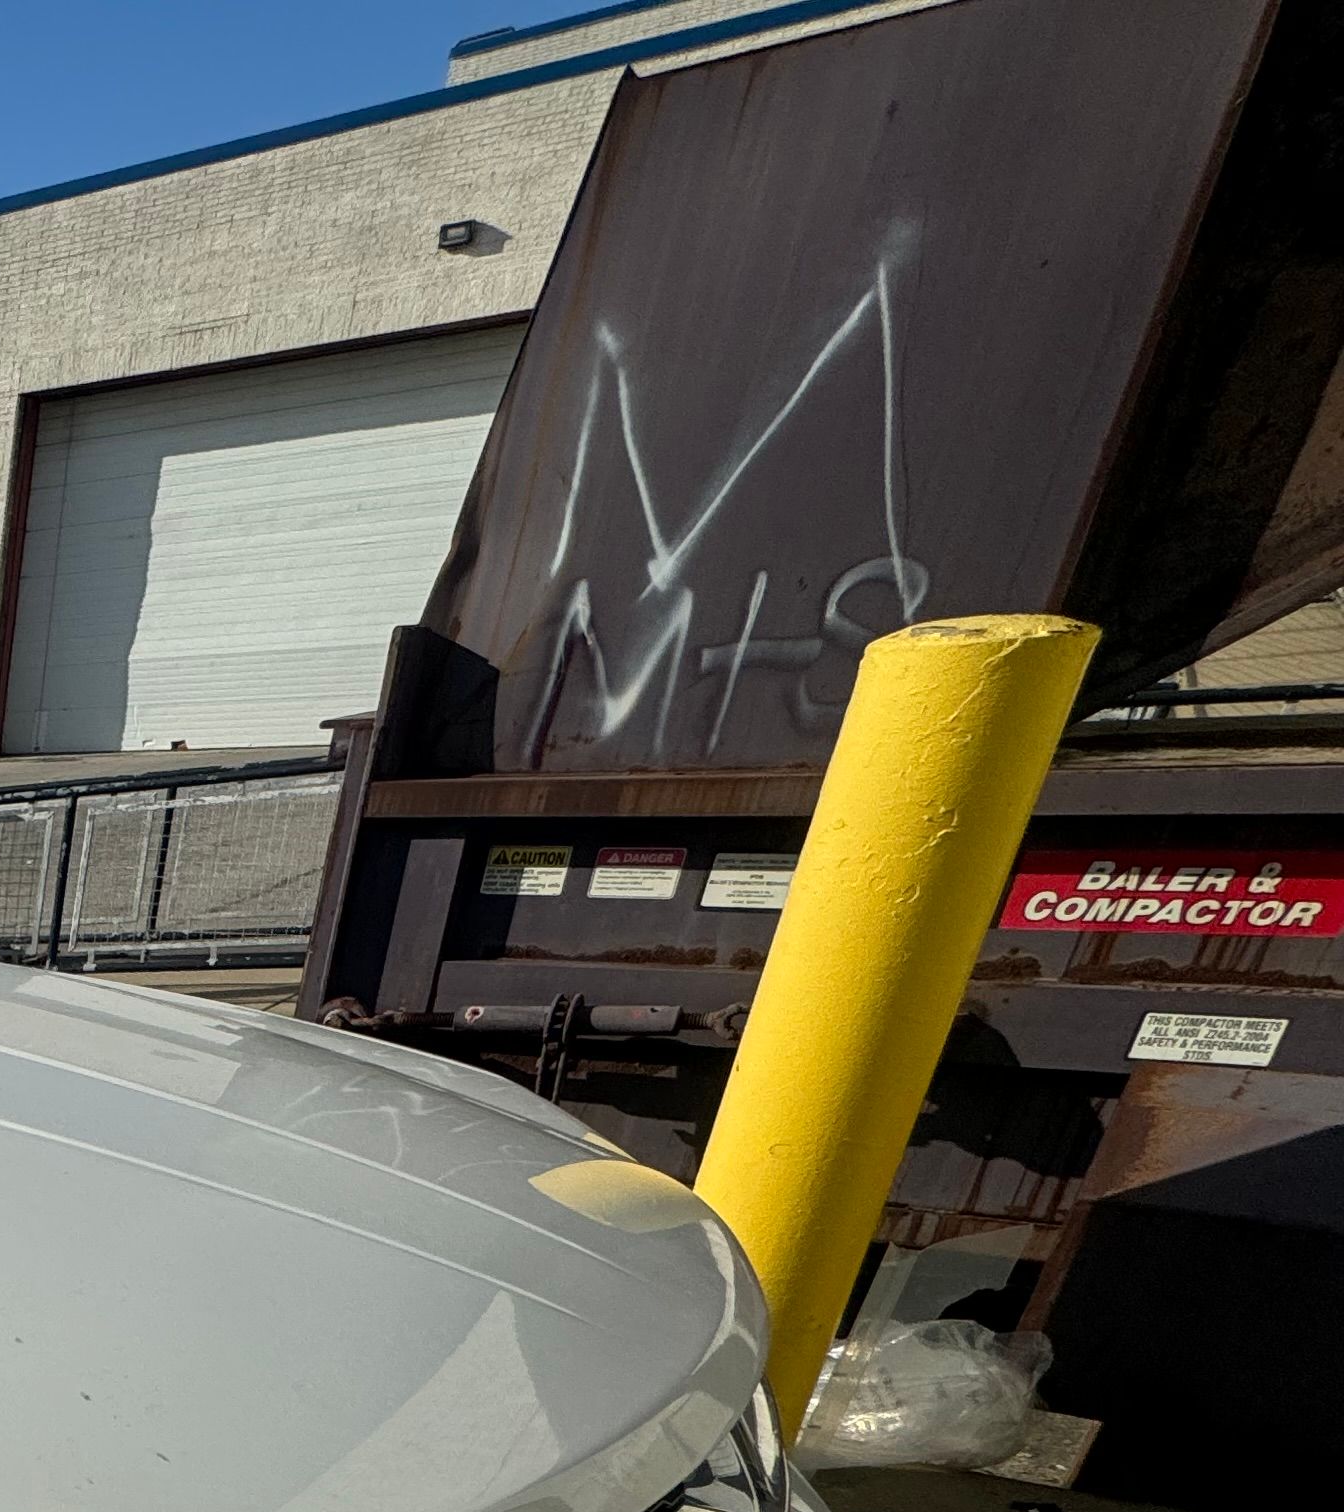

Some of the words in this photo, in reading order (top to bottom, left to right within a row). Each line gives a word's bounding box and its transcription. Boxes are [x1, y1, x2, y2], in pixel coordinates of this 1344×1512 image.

[510, 851, 566, 865] CAUTION
[623, 853, 675, 863] DANGER
[1077, 861, 1236, 892] BALER
[1248, 862, 1282, 893] &
[1024, 891, 1323, 927] COMPACTOR
[1148, 1016, 1172, 1026] THIS
[1174, 1017, 1242, 1029] COMPACTOR
[1243, 1020, 1283, 1032] MEETS
[1151, 1027, 1169, 1037] ALL
[1175, 1028, 1200, 1038] ANSI
[1137, 1037, 1177, 1048] SAFETY
[1179, 1040, 1188, 1049] &
[1190, 1040, 1272, 1054] PERFORMANCE
